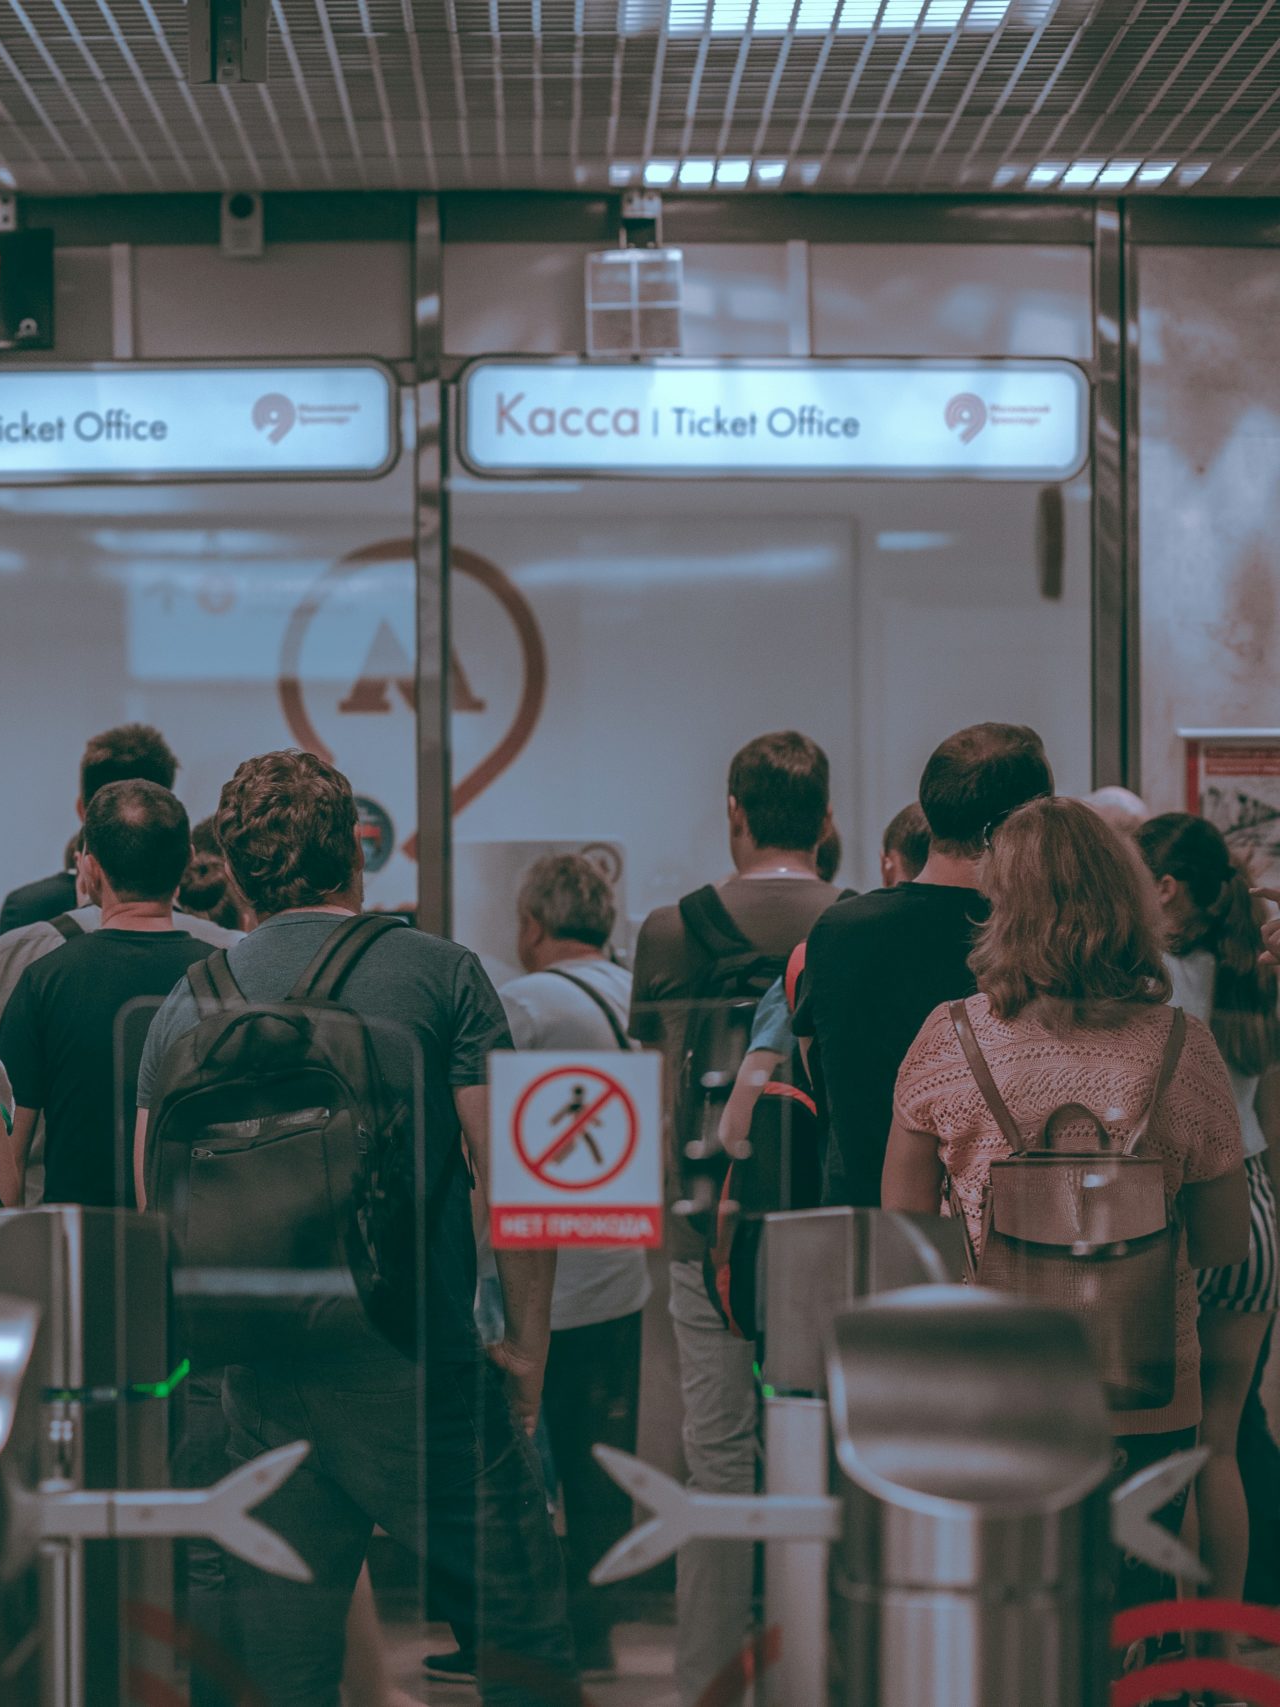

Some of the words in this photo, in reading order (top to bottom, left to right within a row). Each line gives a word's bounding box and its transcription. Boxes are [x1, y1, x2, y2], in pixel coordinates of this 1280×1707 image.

[74, 408, 168, 442] Office
[496, 392, 639, 438] Касса
[672, 405, 757, 439] Ticket
[767, 403, 861, 438] Office
